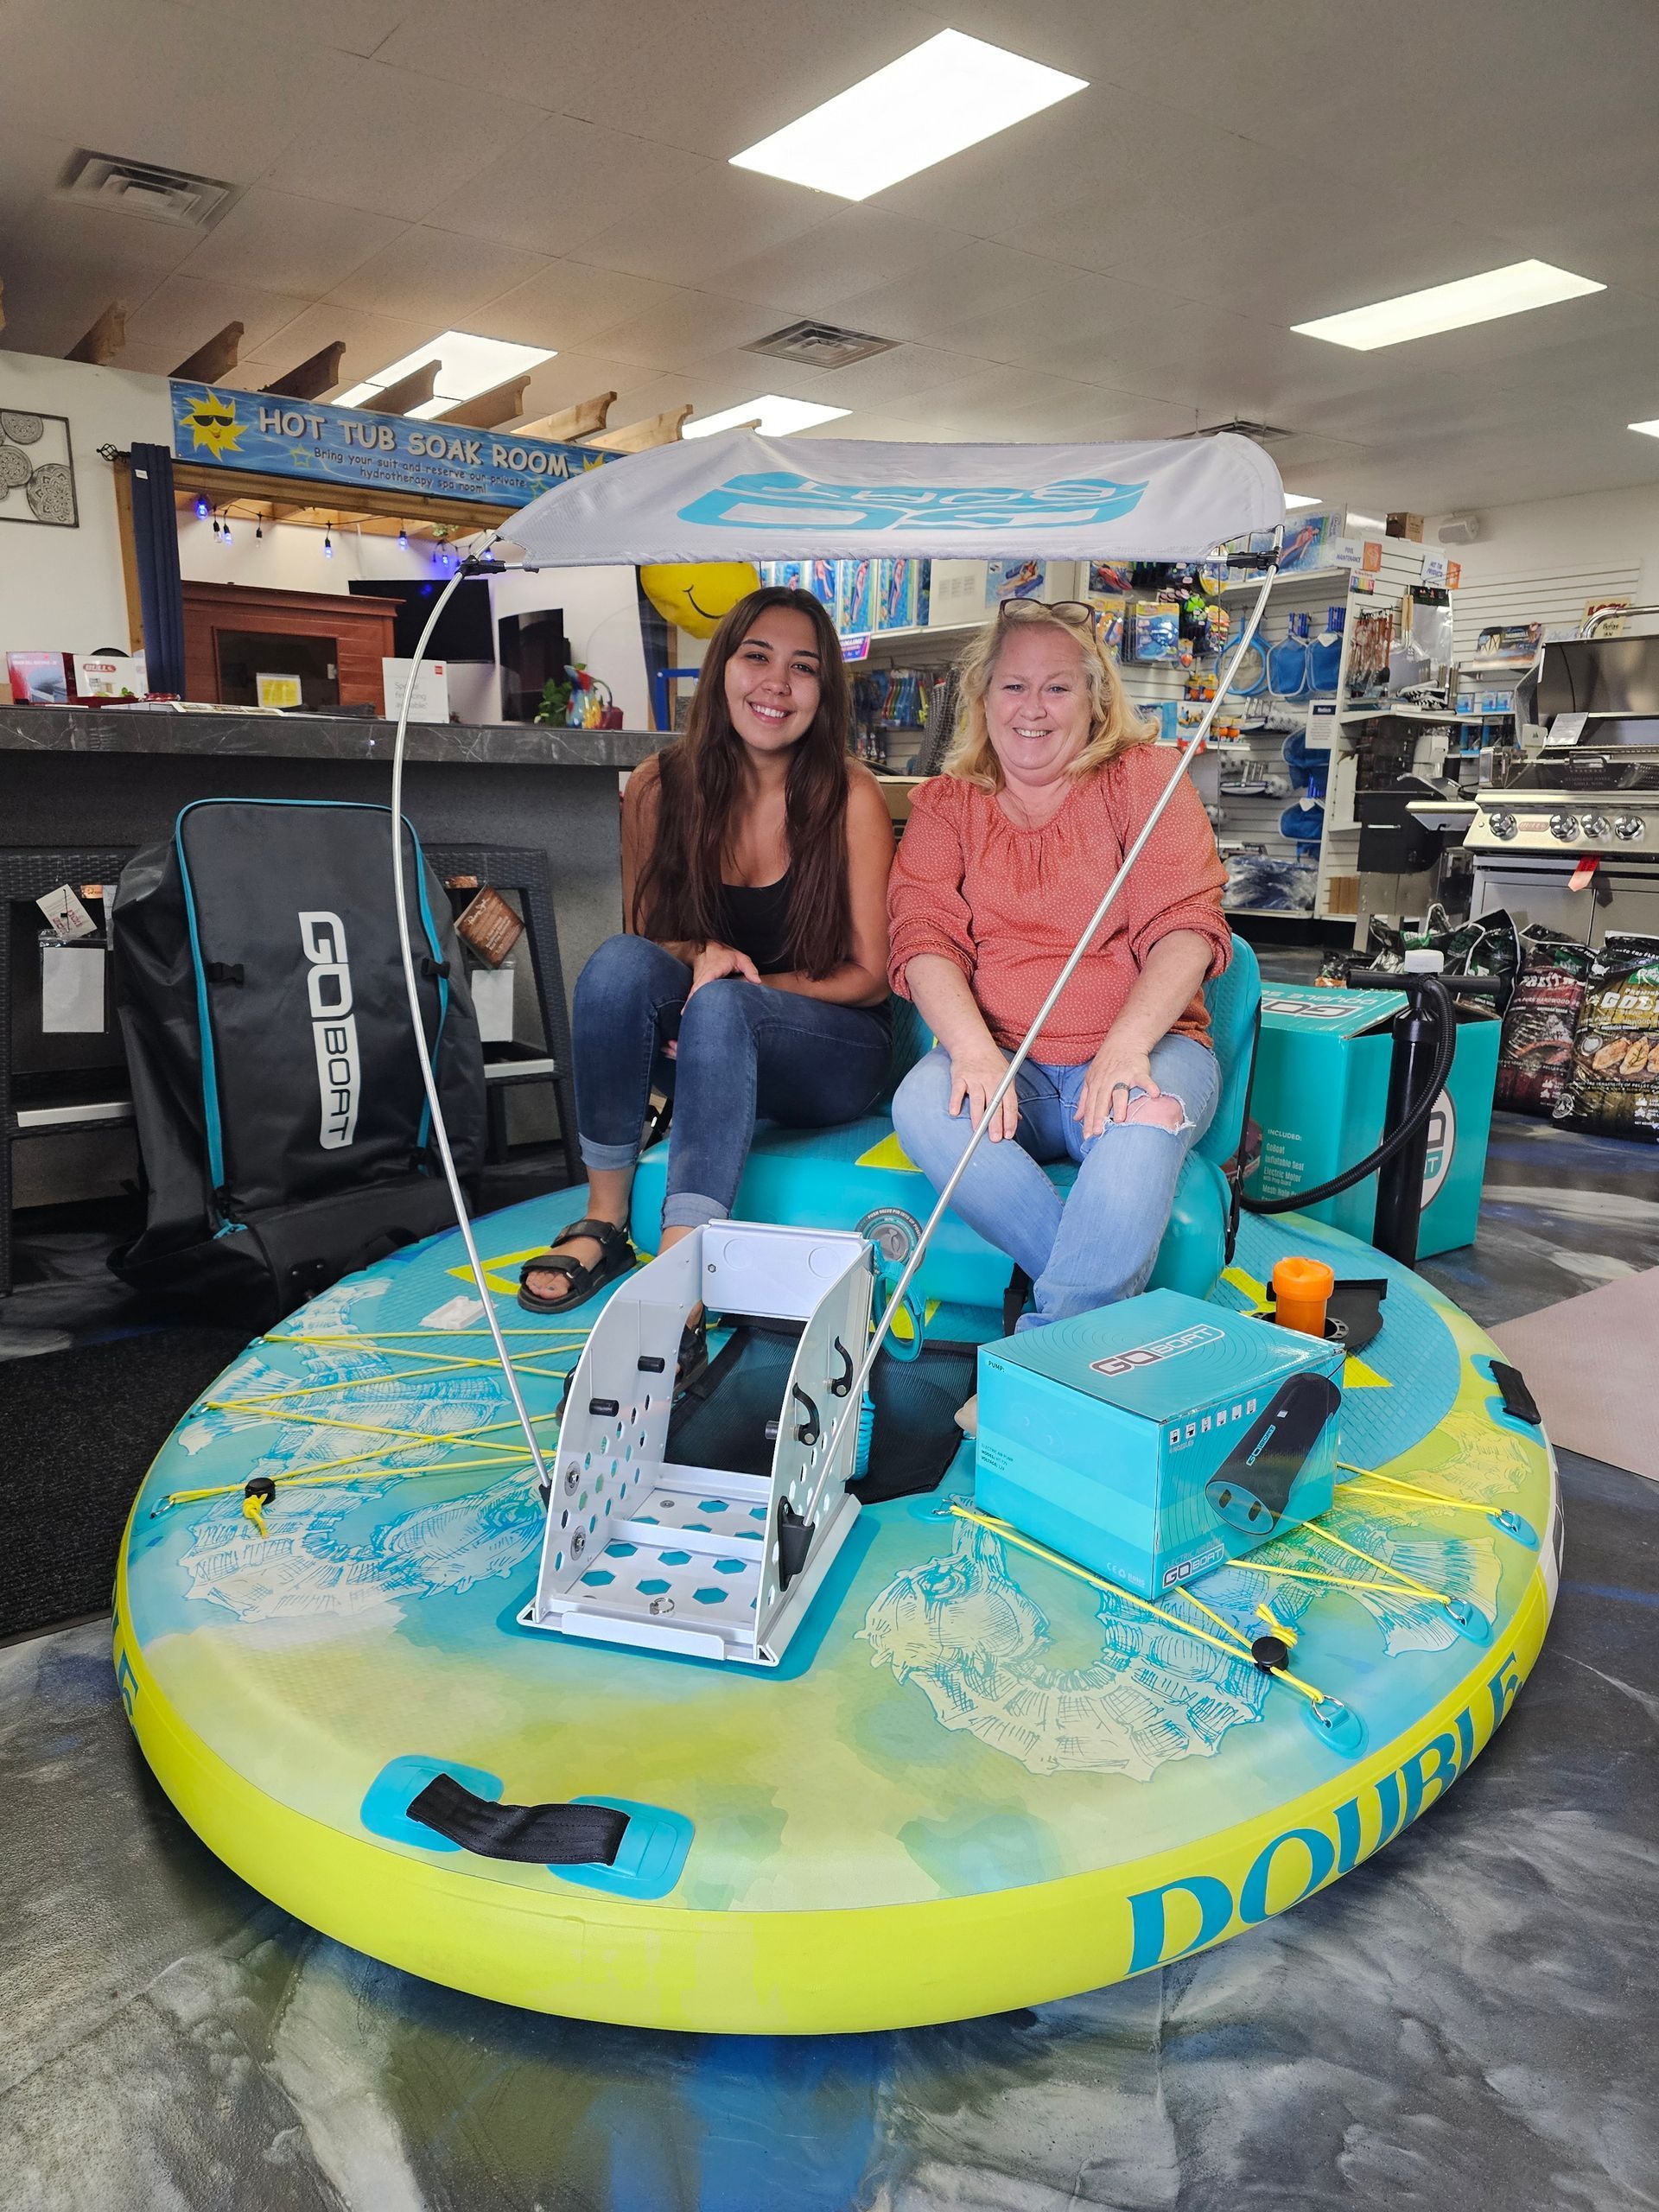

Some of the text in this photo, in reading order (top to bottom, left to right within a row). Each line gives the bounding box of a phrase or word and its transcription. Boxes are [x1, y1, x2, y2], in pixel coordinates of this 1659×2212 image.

[259, 406, 569, 479] HOT TUB SOAK ROOM
[314, 448, 526, 487] Bring your suit and reserve our private
[360, 467, 433, 489] hydrotherapy
[438, 480, 455, 490] spa
[1268, 1129, 1302, 1141] INCLUDED:
[1265, 1155, 1304, 1171] Inflatable Seat
[1264, 1166, 1301, 1182] Electric Motor
[1262, 1185, 1278, 1194] Mesh
[988, 1360, 1005, 1373] PUMP:
[1163, 1549, 1195, 1570] ELECTRIC
